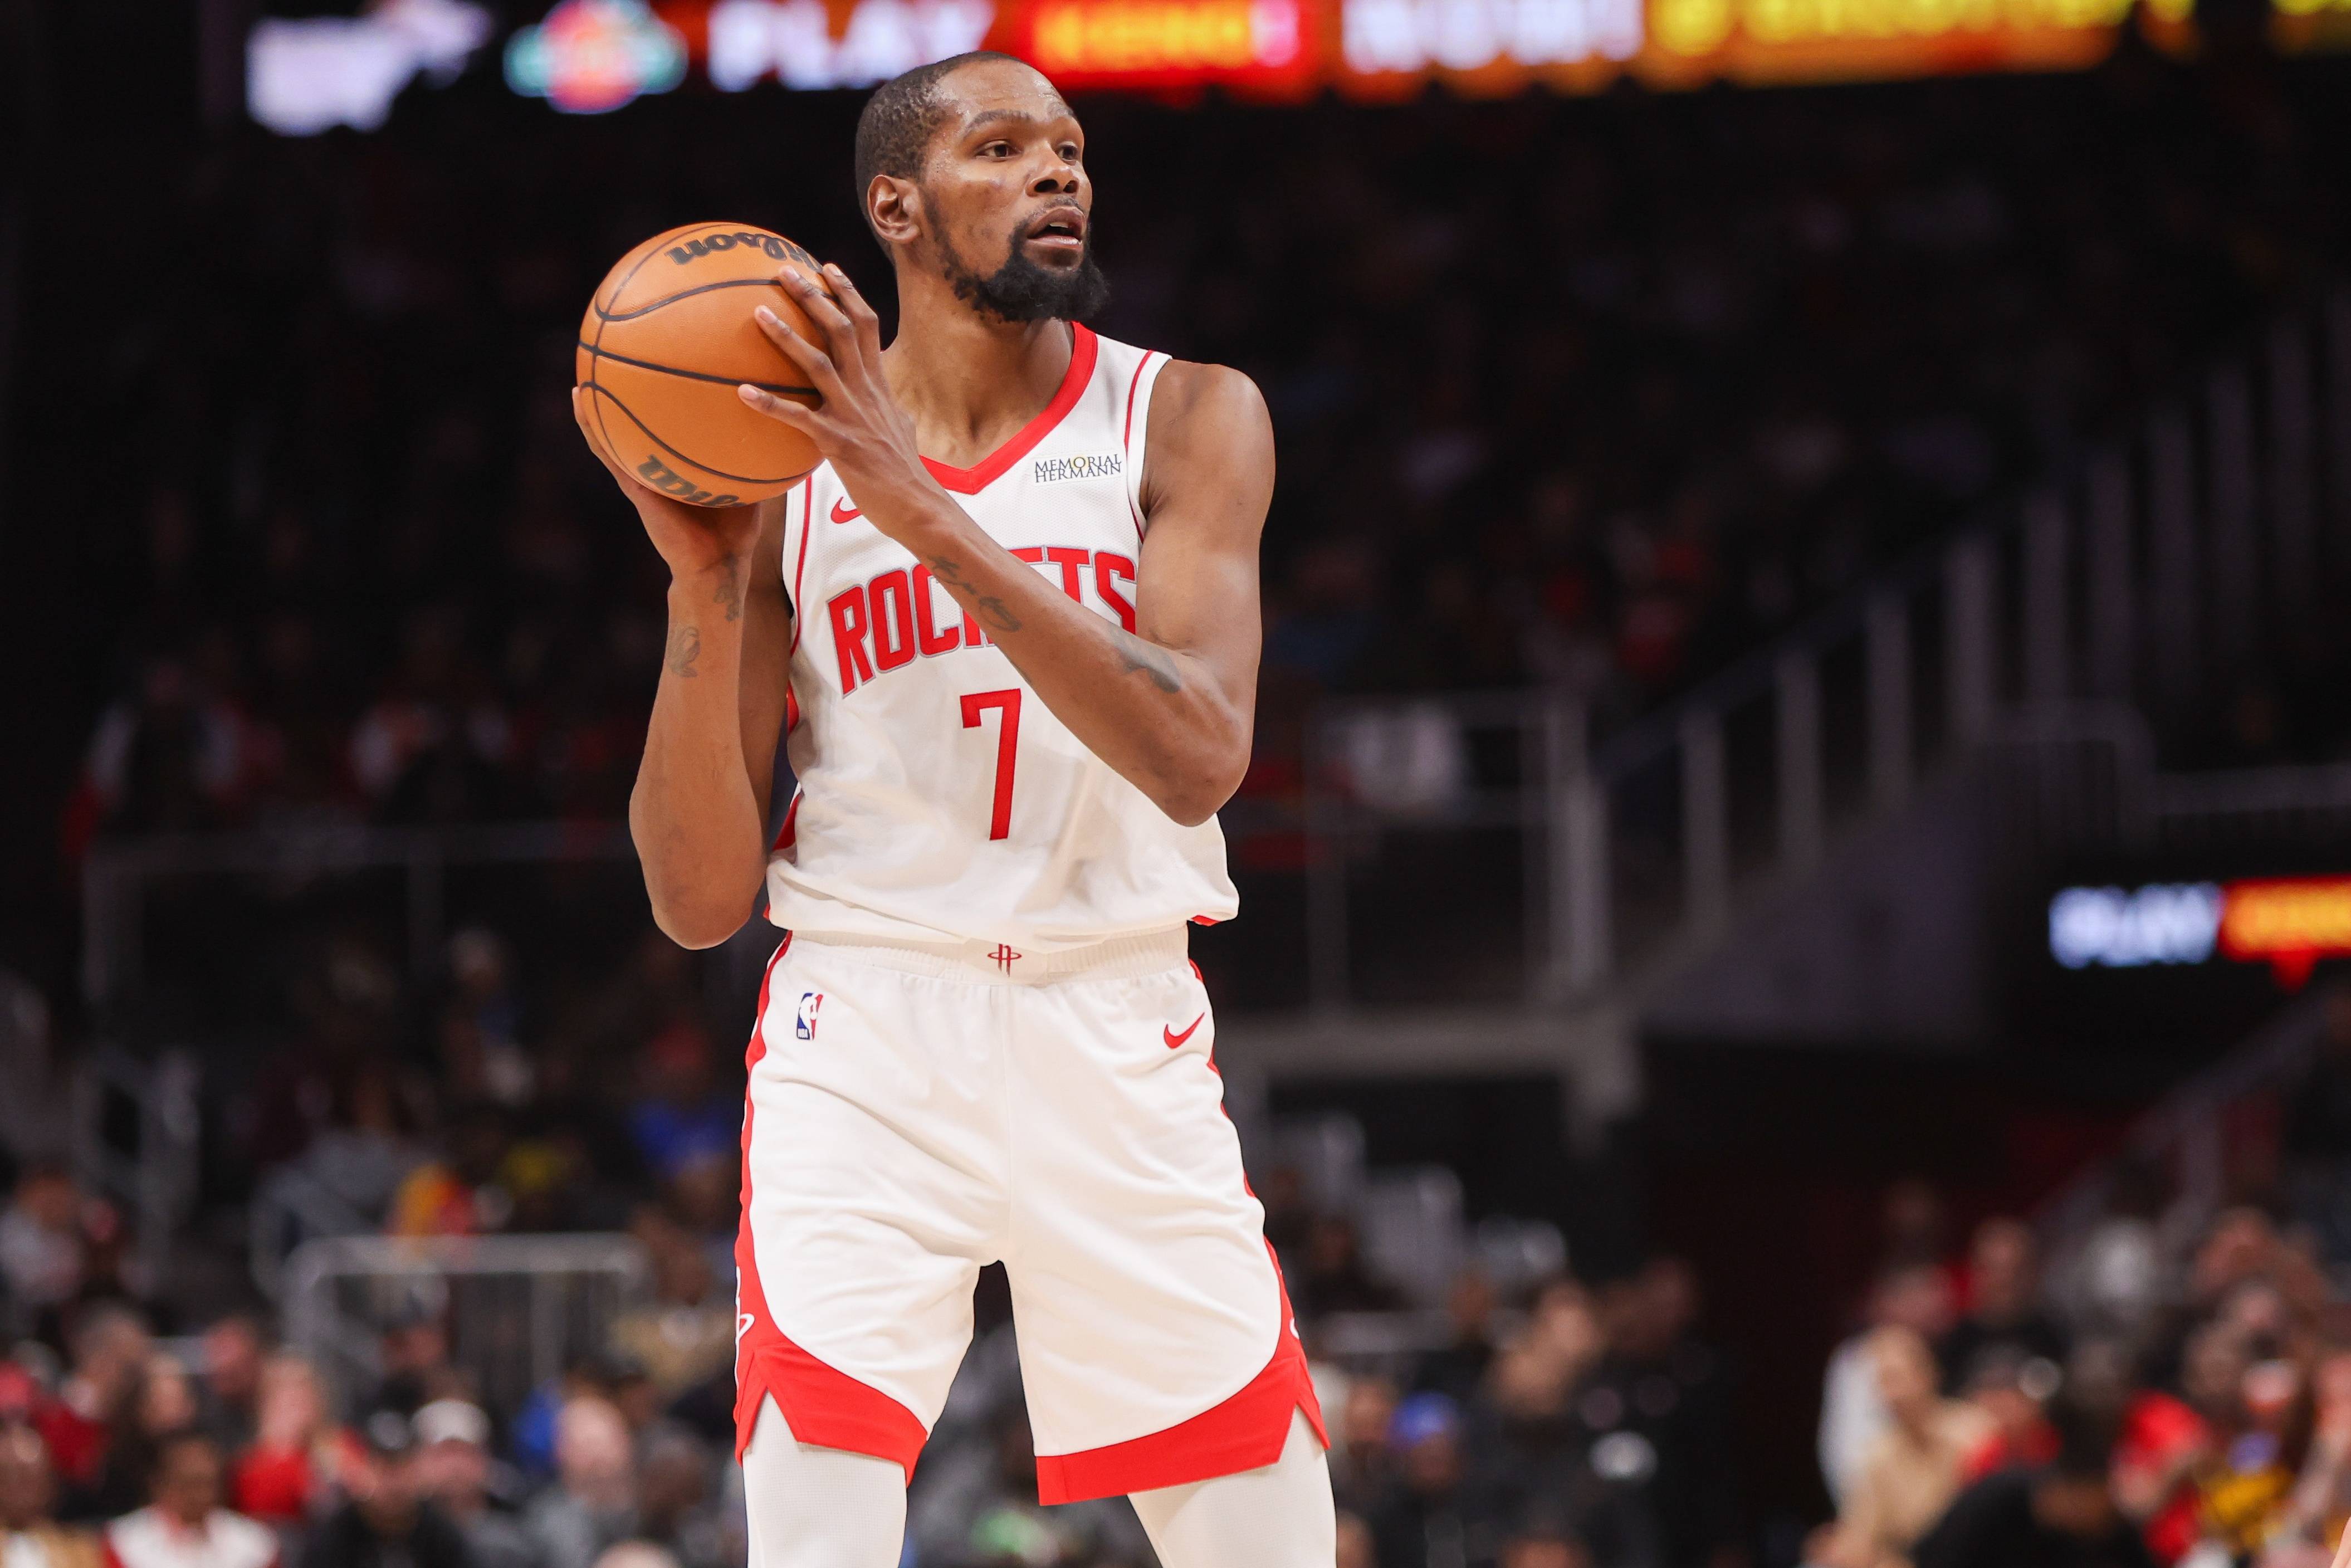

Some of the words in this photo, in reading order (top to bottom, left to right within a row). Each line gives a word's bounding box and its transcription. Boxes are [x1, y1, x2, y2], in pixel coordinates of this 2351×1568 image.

[638, 454, 747, 507] Wil
[1035, 454, 1122, 473] MEMORIAL
[1035, 463, 1121, 483] HERMANN
[827, 544, 1137, 698] ROCTS
[959, 688, 1022, 841] 7
